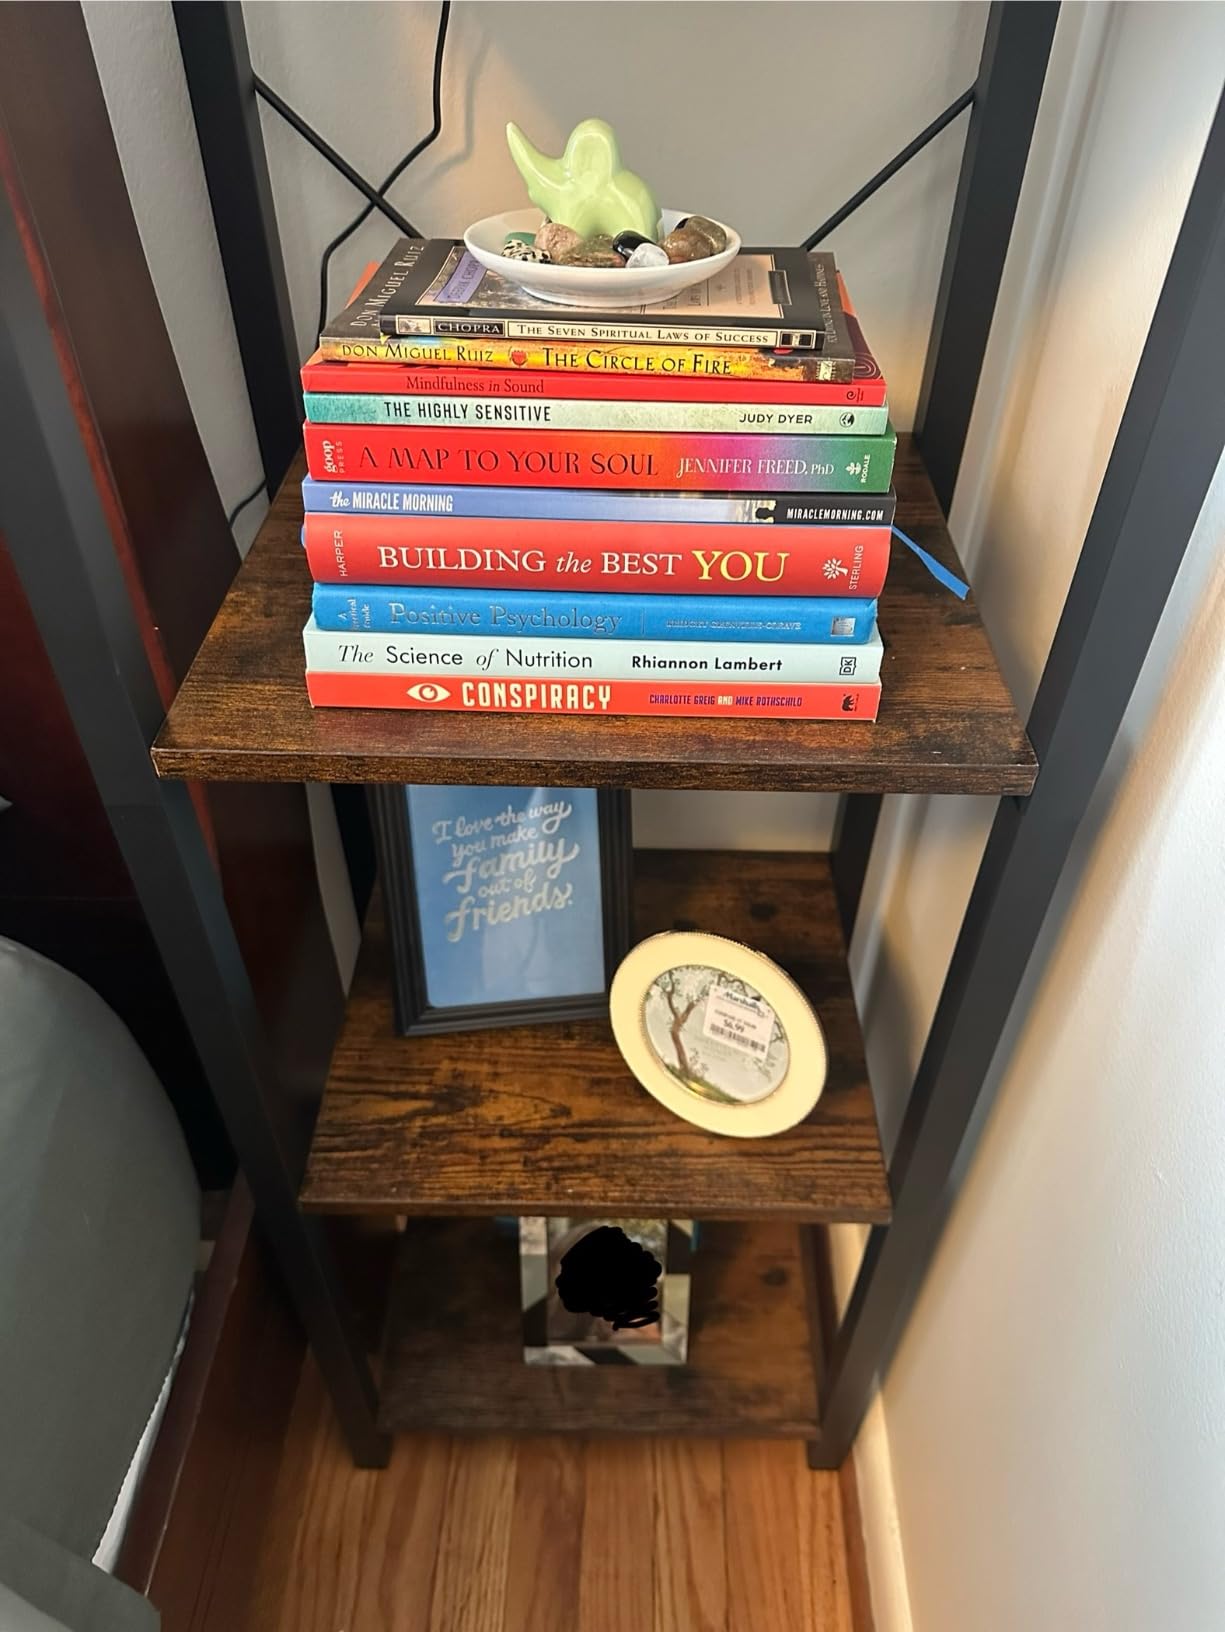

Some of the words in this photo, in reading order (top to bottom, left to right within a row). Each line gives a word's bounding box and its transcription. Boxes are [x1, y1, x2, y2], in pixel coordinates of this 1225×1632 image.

[350, 310, 378, 326] DON
[364, 271, 408, 307] MIGUEL
[394, 246, 424, 267] RUIZ
[437, 323, 500, 334] CHOPRA
[517, 325, 541, 335] THE
[547, 326, 588, 336] SEVEN
[591, 328, 652, 339] SPIRITUAL
[657, 330, 689, 341] LAWS
[695, 332, 710, 341] OF
[716, 332, 768, 344] SUCCESS
[342, 345, 378, 357] DON
[384, 344, 451, 361] MIGUEL
[457, 346, 493, 363] RUIZ
[543, 348, 579, 367] THE
[586, 350, 654, 372] CIRCLE
[662, 358, 685, 373] OF
[693, 354, 731, 375] FIRE
[406, 376, 484, 392] Mindfulness
[488, 378, 500, 393] in
[504, 377, 544, 393] Sound
[384, 402, 411, 418] THE
[418, 402, 468, 419] HIGHLY
[476, 404, 551, 421] SENSITIVE
[739, 414, 774, 424] JUDY
[778, 414, 813, 424] DYER
[322, 440, 337, 473] goop
[336, 441, 345, 473] PRESS
[359, 447, 378, 469] A
[388, 447, 450, 470] MAP
[458, 449, 499, 472] TO
[506, 450, 579, 474] YOUR
[590, 453, 658, 476] SOUL
[676, 457, 752, 479] JENNIFER
[811, 463, 834, 475] PhD
[860, 454, 871, 483] RODALE
[330, 491, 350, 507] the
[353, 492, 399, 510] MIRACLE
[403, 494, 453, 512] MORNING
[786, 508, 884, 521] MIRACLEMORNING.COM
[333, 530, 348, 577] HARPER
[377, 546, 546, 572] BUILDING
[556, 551, 592, 573] the
[601, 552, 682, 576] BEST
[692, 550, 790, 582] YOU
[849, 545, 864, 590] STERLING
[389, 602, 480, 626] Positive
[490, 605, 622, 634] Psychology
[338, 644, 374, 663] The
[386, 645, 463, 666] Science
[476, 648, 499, 671] of
[506, 649, 593, 669] Nutrition
[632, 655, 708, 671] Rhiannon
[715, 657, 783, 671] Lambert
[461, 682, 611, 711] CONSPIRACY
[650, 694, 691, 705] CHARLOTTE
[694, 695, 715, 706] GREIG
[717, 695, 733, 706] AND
[736, 696, 753, 706] MIKE
[756, 696, 802, 707] ROTHSCHILD
[432, 820, 452, 844] I
[455, 816, 493, 837] love
[495, 805, 527, 826] the
[529, 801, 572, 834] way
[451, 843, 487, 868] you
[491, 825, 538, 849] make
[442, 838, 580, 894] family
[478, 879, 511, 899] out
[514, 869, 537, 893] of
